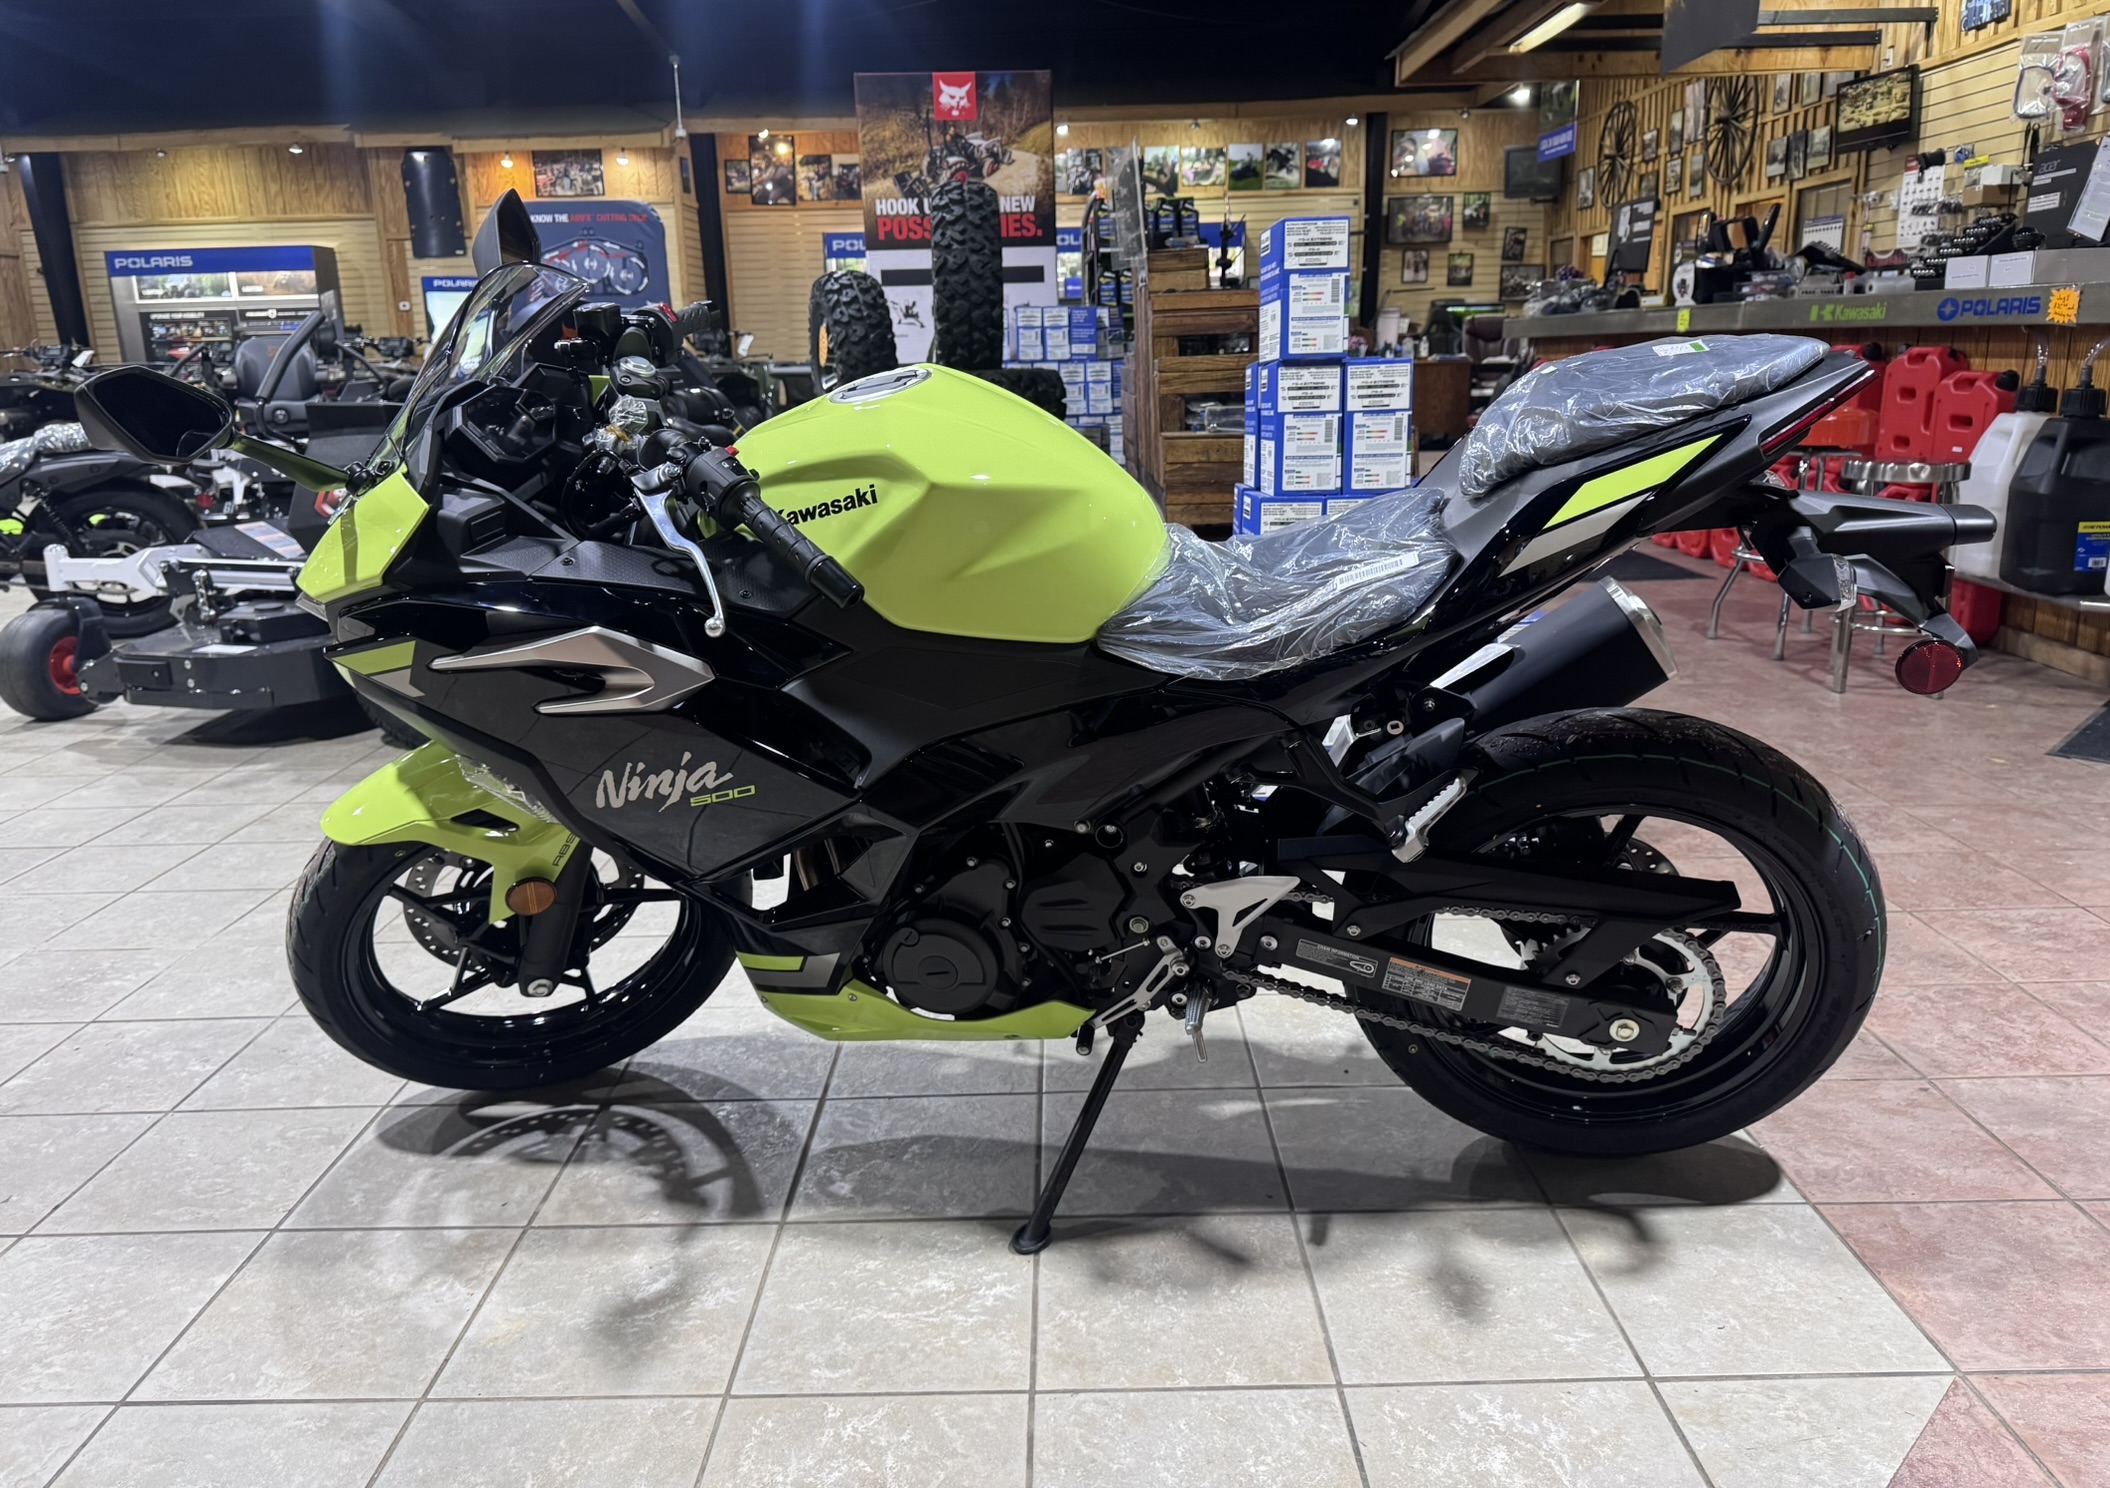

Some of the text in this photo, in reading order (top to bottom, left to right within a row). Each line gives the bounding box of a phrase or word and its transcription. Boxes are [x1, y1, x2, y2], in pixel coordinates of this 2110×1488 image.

[875, 197, 920, 215] HOOK
[999, 195, 1036, 213] NEW
[554, 213, 569, 222] THE
[114, 255, 194, 269] POLARIS
[1834, 301, 1888, 321] Kawasaki
[1960, 296, 2042, 316] POLARIS
[778, 484, 878, 525] awasaki
[596, 751, 734, 812] Ninja
[690, 785, 755, 807] 500
[552, 832, 577, 867] ABS
